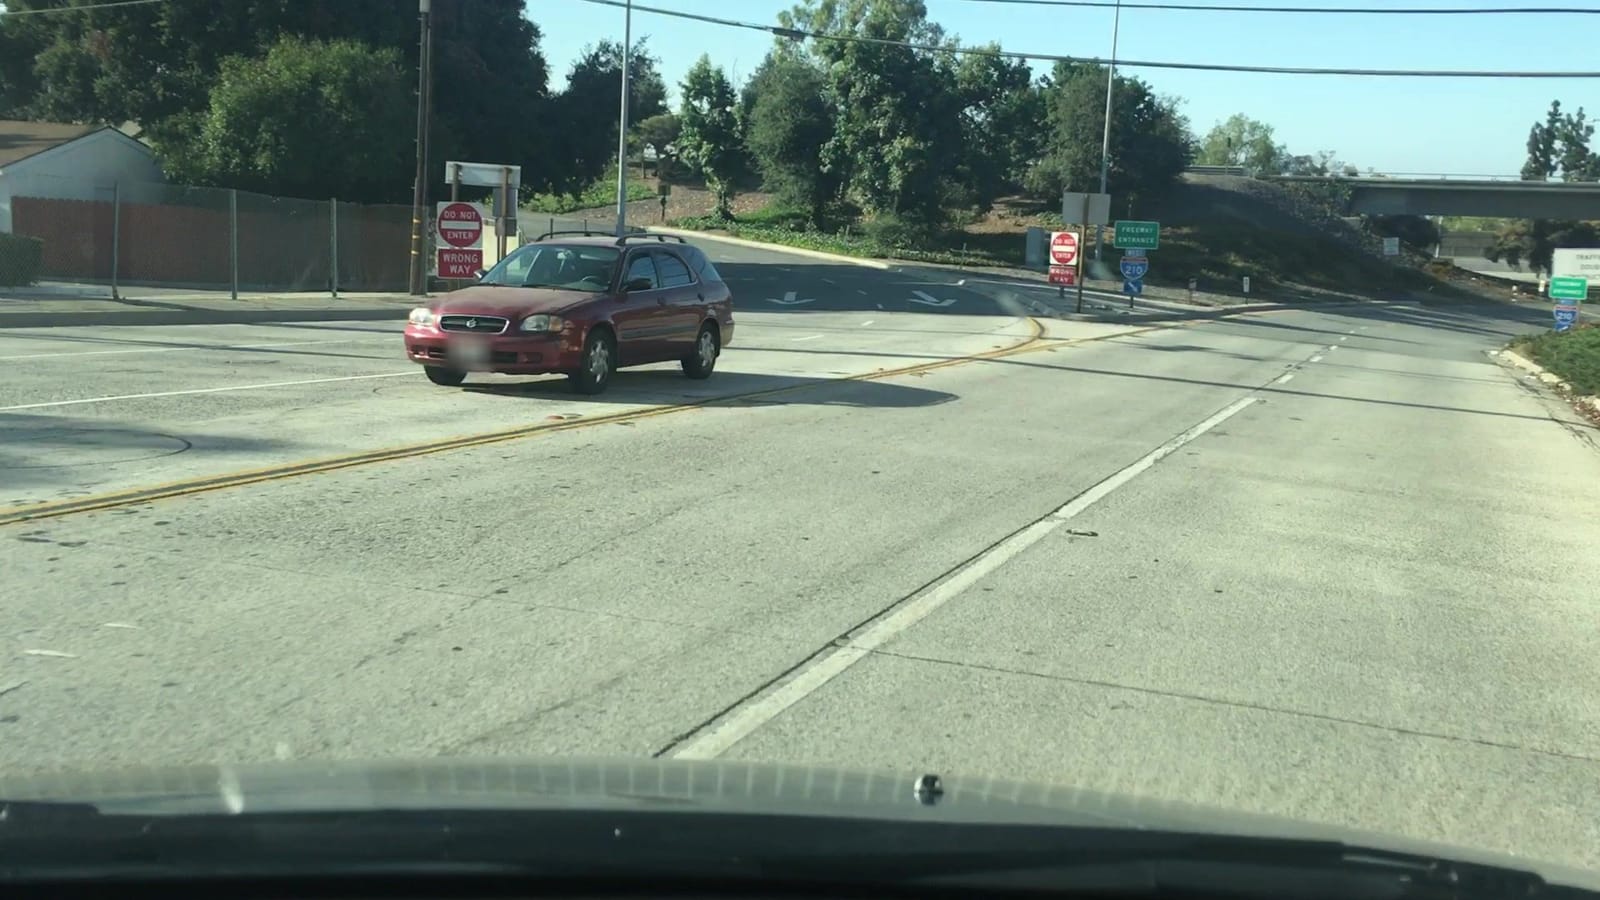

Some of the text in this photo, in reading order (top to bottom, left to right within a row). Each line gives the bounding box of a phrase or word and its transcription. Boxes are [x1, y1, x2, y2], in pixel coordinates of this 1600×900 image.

[447, 231, 473, 239] ENTER
[443, 254, 478, 263] WRONG
[449, 265, 471, 274] WAY
[1125, 265, 1143, 275] 210
